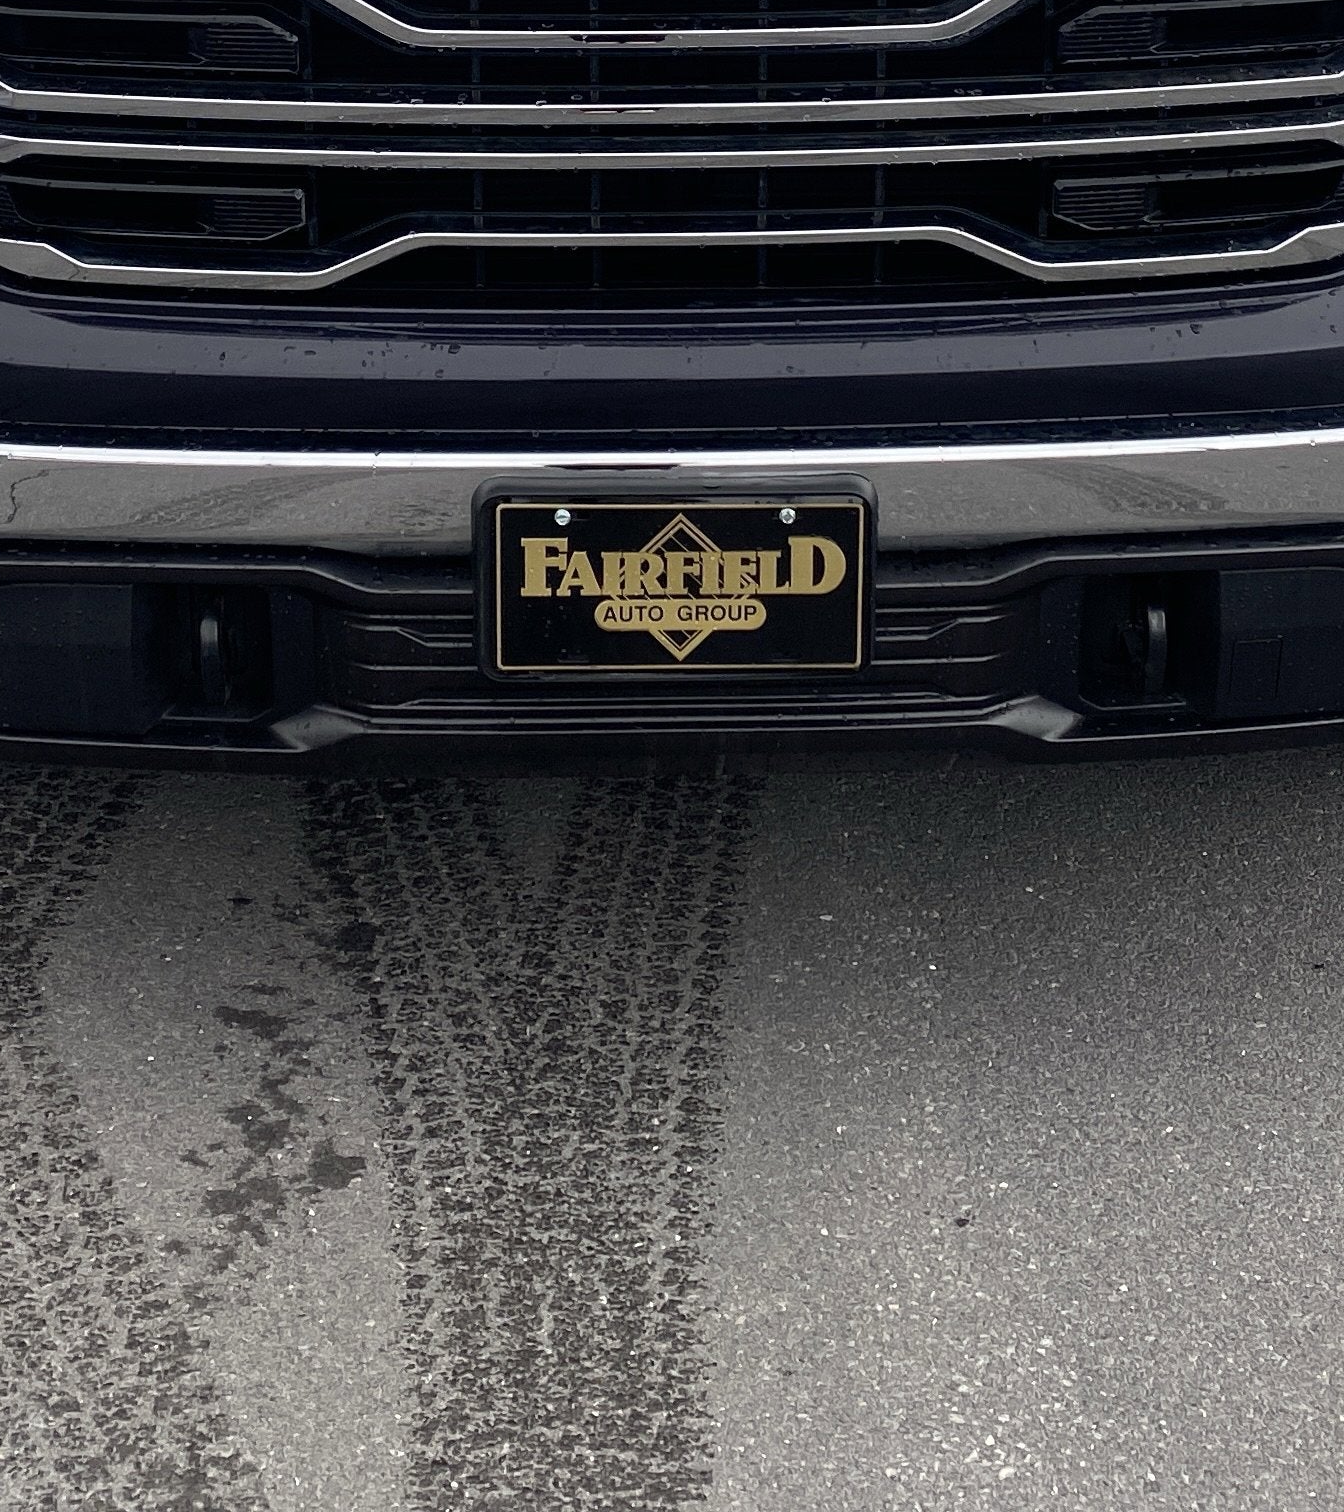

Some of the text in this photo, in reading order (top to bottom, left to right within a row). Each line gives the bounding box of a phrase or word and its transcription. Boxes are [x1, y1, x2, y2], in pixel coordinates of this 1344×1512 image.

[521, 536, 846, 597] FAIRFIELD
[603, 605, 757, 622] AUTO GROUP
